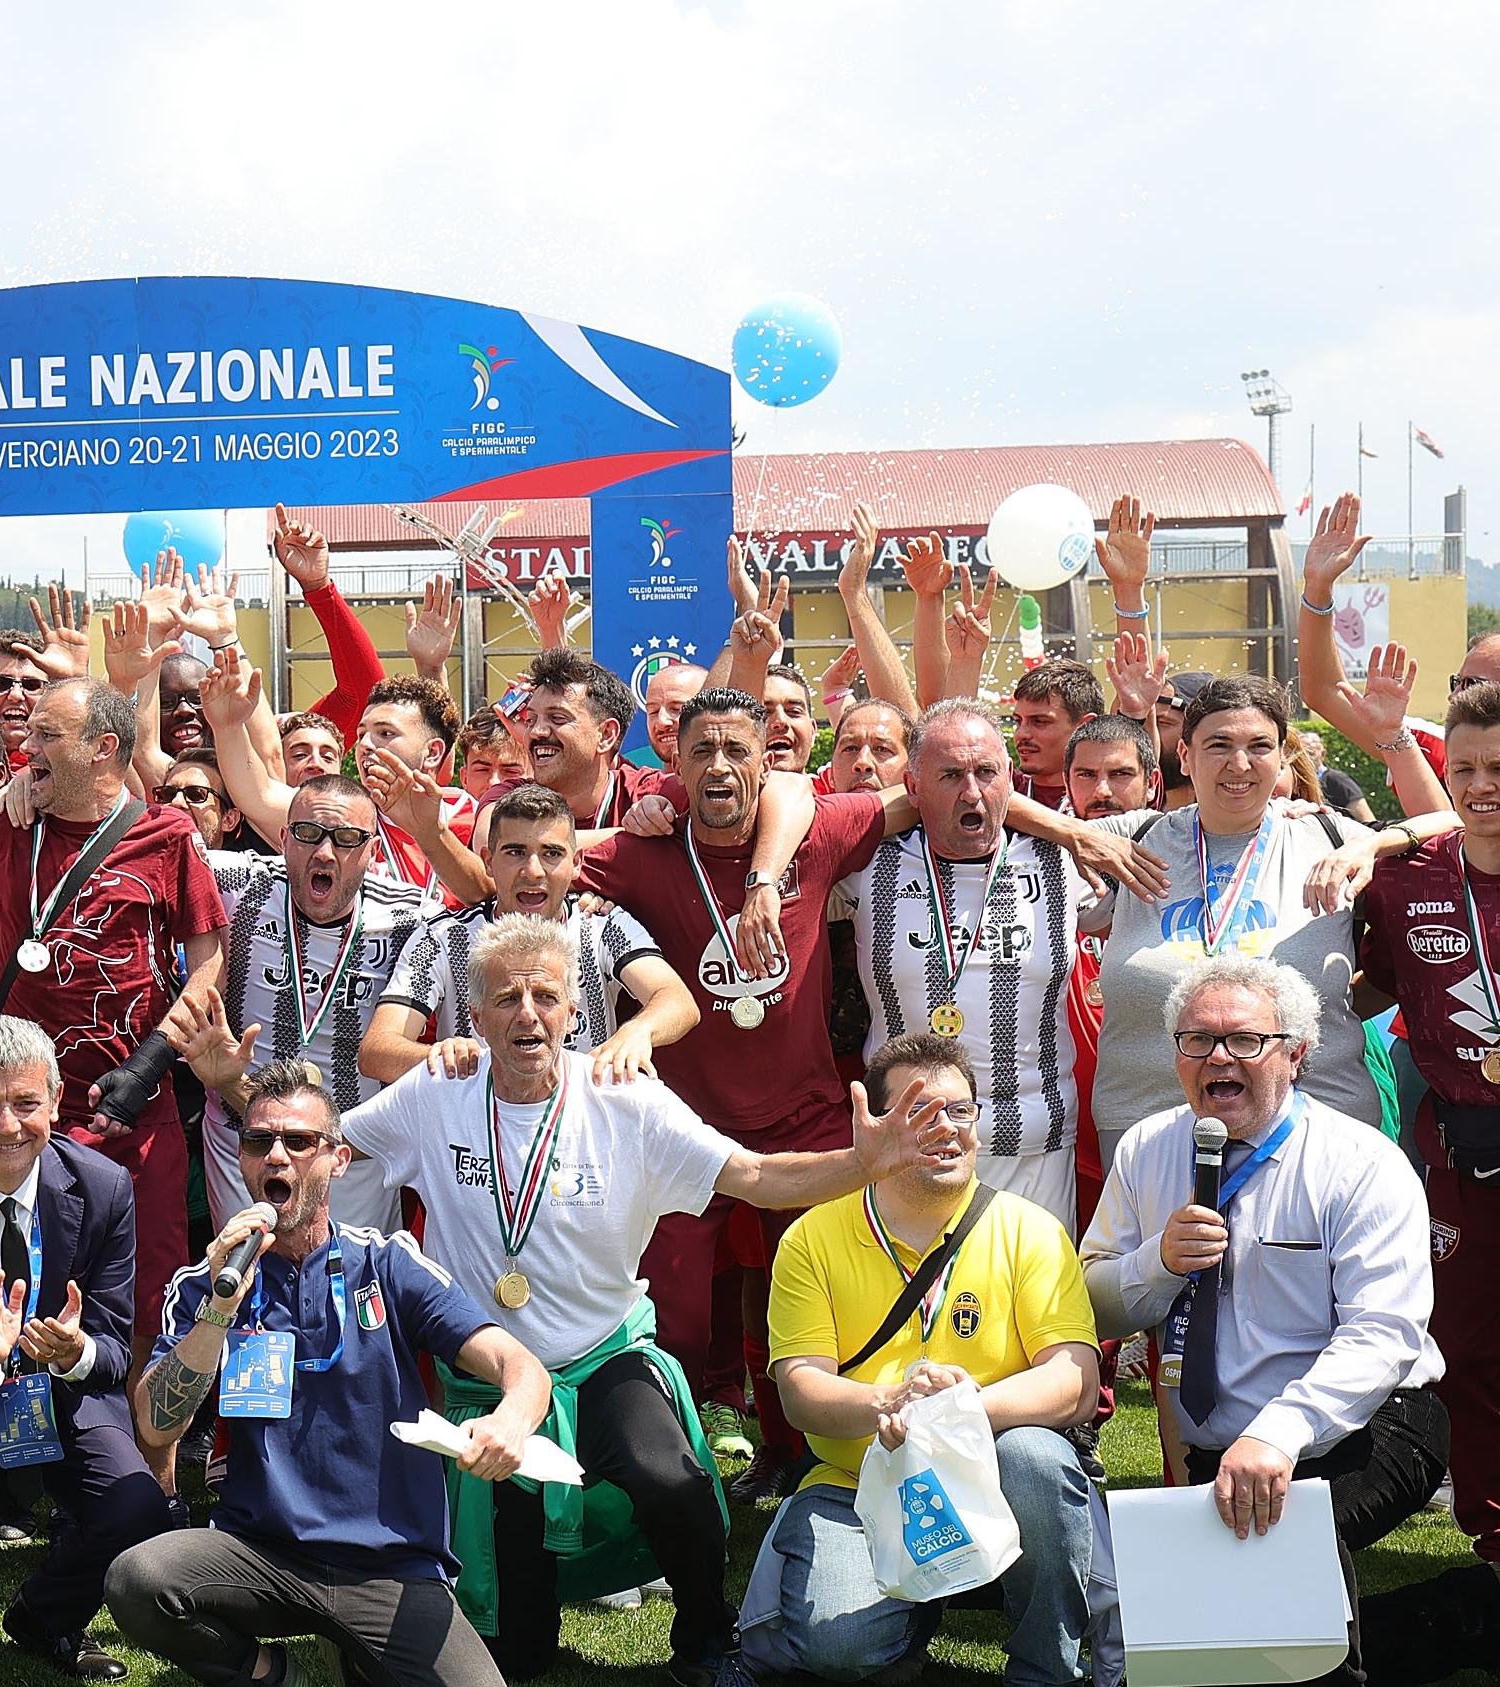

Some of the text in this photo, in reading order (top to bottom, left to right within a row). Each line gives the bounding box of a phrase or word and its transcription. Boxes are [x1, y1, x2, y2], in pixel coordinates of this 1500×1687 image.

[90, 344, 395, 407] NAZIONALE
[471, 422, 506, 434] FIGC
[129, 435, 200, 465] 20-21
[214, 431, 321, 462] MAGGIO
[330, 428, 399, 458] 2023
[442, 436, 536, 448] CALCIO PARALIMPICO
[451, 445, 527, 456] E SPERIMENTALE
[650, 576, 676, 585] FIGC
[896, 891, 927, 900] adidas
[254, 929, 284, 943] adidas
[1409, 933, 1467, 953] Beretta
[1431, 1222, 1456, 1238] TORINO
[911, 1523, 959, 1549] MUSEO DEL
[916, 1531, 964, 1557] CALCIO
